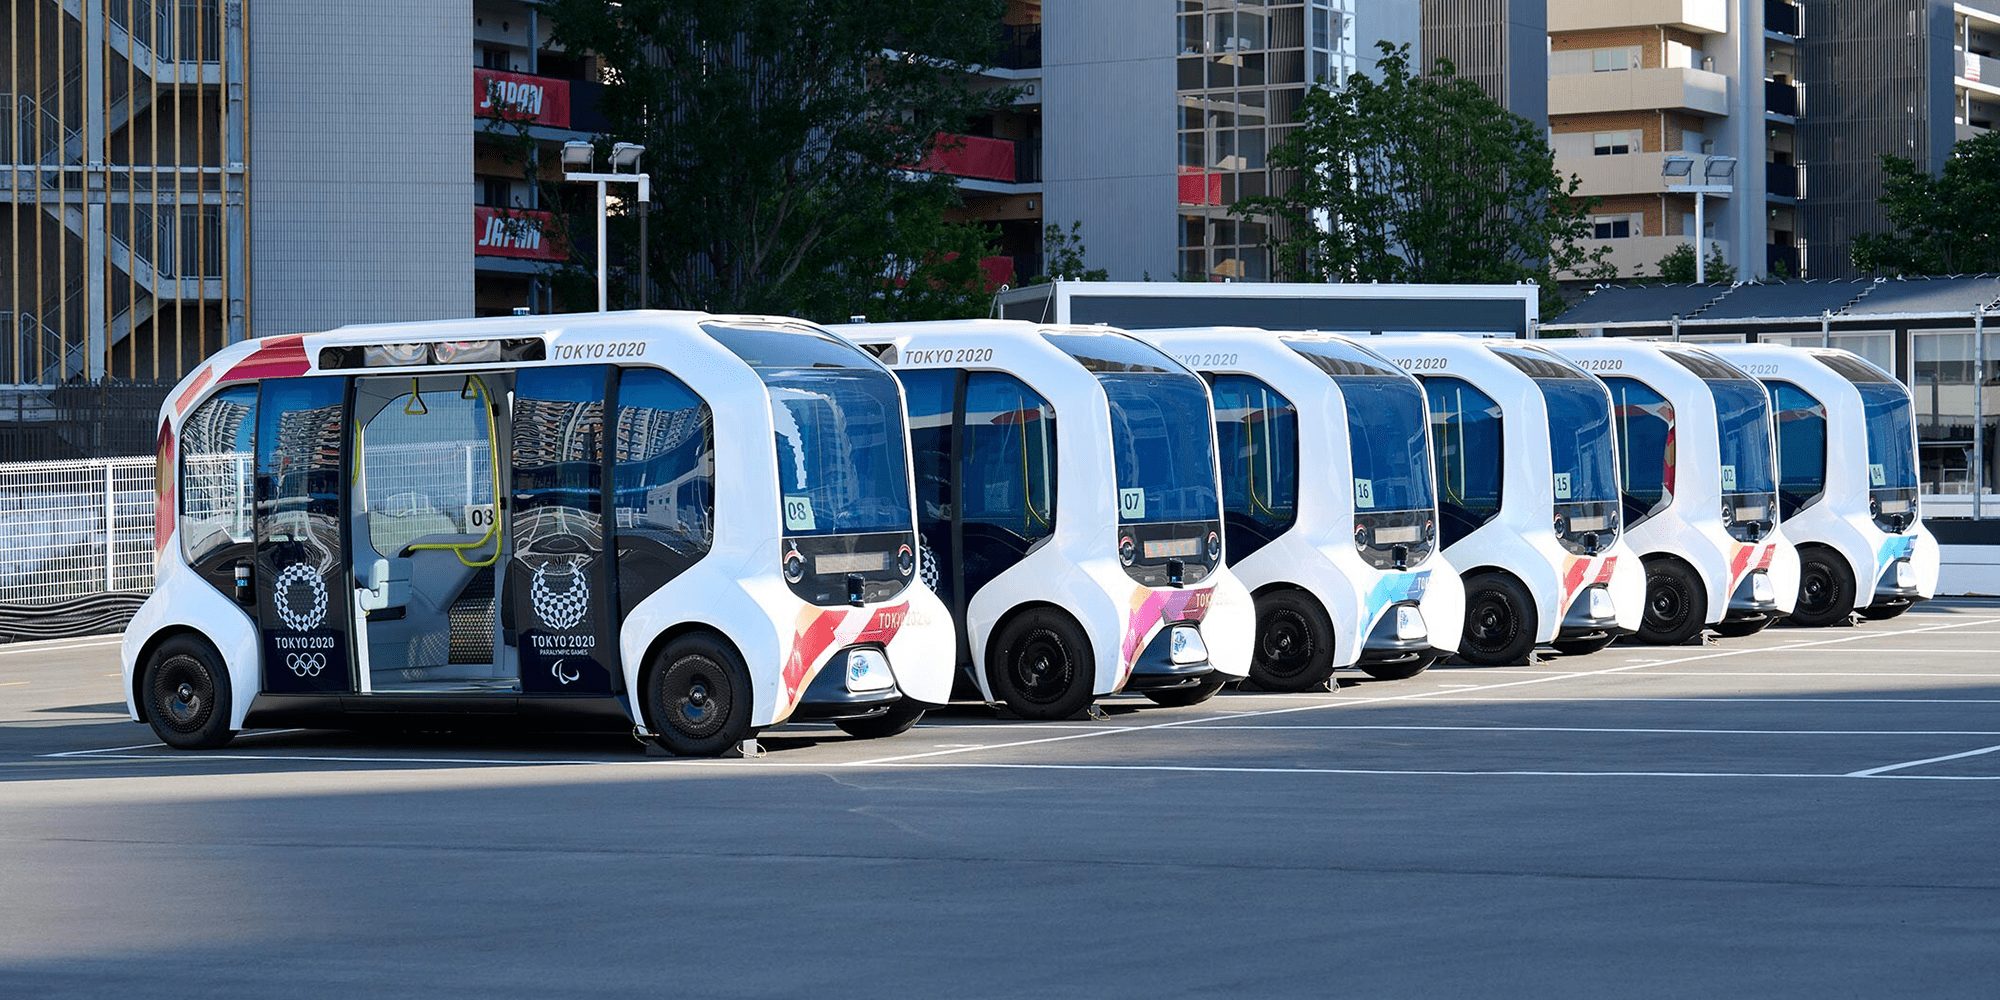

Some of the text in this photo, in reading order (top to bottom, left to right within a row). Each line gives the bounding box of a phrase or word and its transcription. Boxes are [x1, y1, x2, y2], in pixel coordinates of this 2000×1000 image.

[480, 80, 543, 115] JAPAN
[554, 342, 646, 360] TOKYO 2020
[905, 348, 993, 364] TOKYO 2020
[1203, 353, 1238, 366] 2020
[1414, 357, 1448, 370] 2020
[1591, 359, 1623, 370] 2020
[1749, 364, 1779, 375] 2020
[1723, 468, 1734, 482] 02
[1358, 482, 1369, 499] 16
[1557, 476, 1568, 491] 15
[1124, 493, 1140, 511] 07
[471, 508, 495, 527] 08
[788, 502, 807, 521] 08
[275, 636, 335, 649] TOKYO 2020
[531, 635, 595, 648] TOKYO 2020
[570, 648, 588, 656] GAMES
